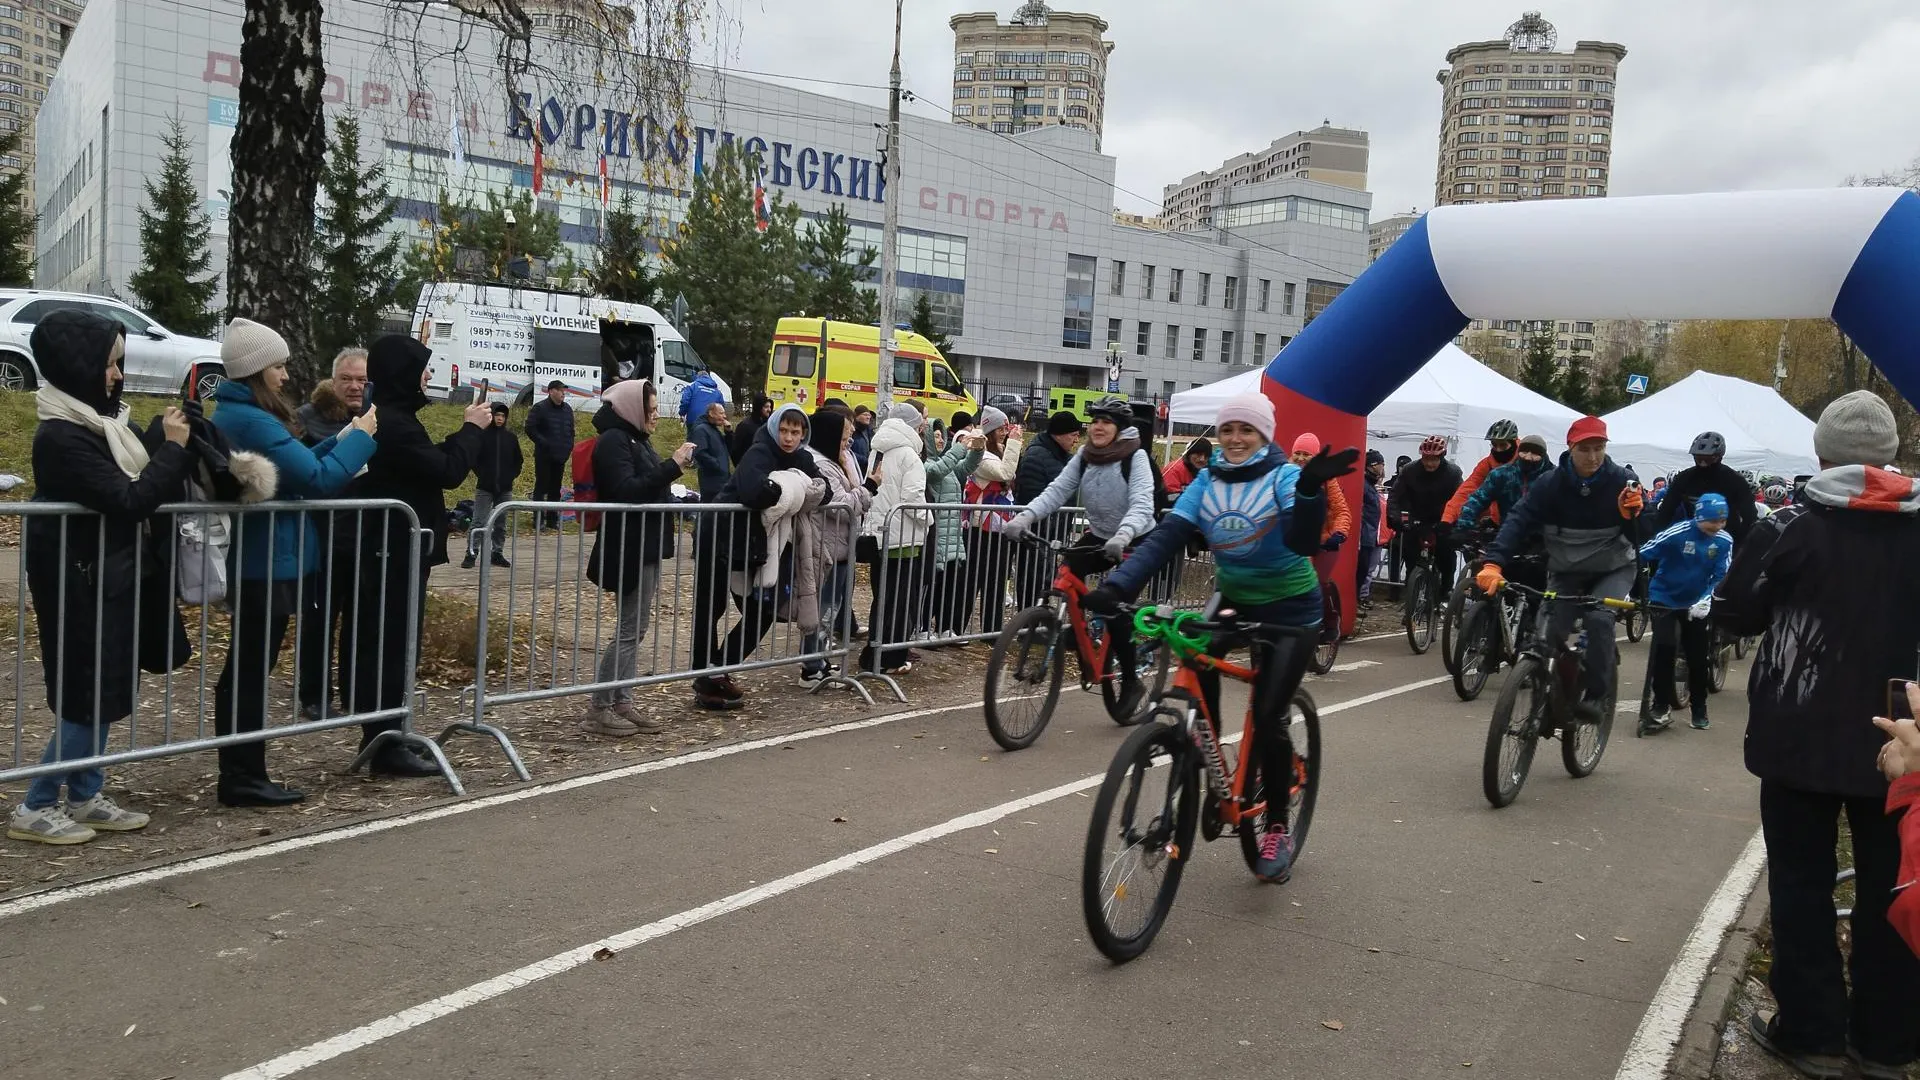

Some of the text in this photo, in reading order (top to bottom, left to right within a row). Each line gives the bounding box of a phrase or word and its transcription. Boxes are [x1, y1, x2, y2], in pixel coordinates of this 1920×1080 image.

[202, 50, 480, 134] ДОРЕЦ
[919, 186, 1069, 233] СПОРТА
[470, 326, 493, 337] (985)
[514, 330, 525, 339] 59
[494, 342, 511, 351] 447
[513, 343, 525, 352] 77
[840, 383, 861, 391] СКОРАЯ
